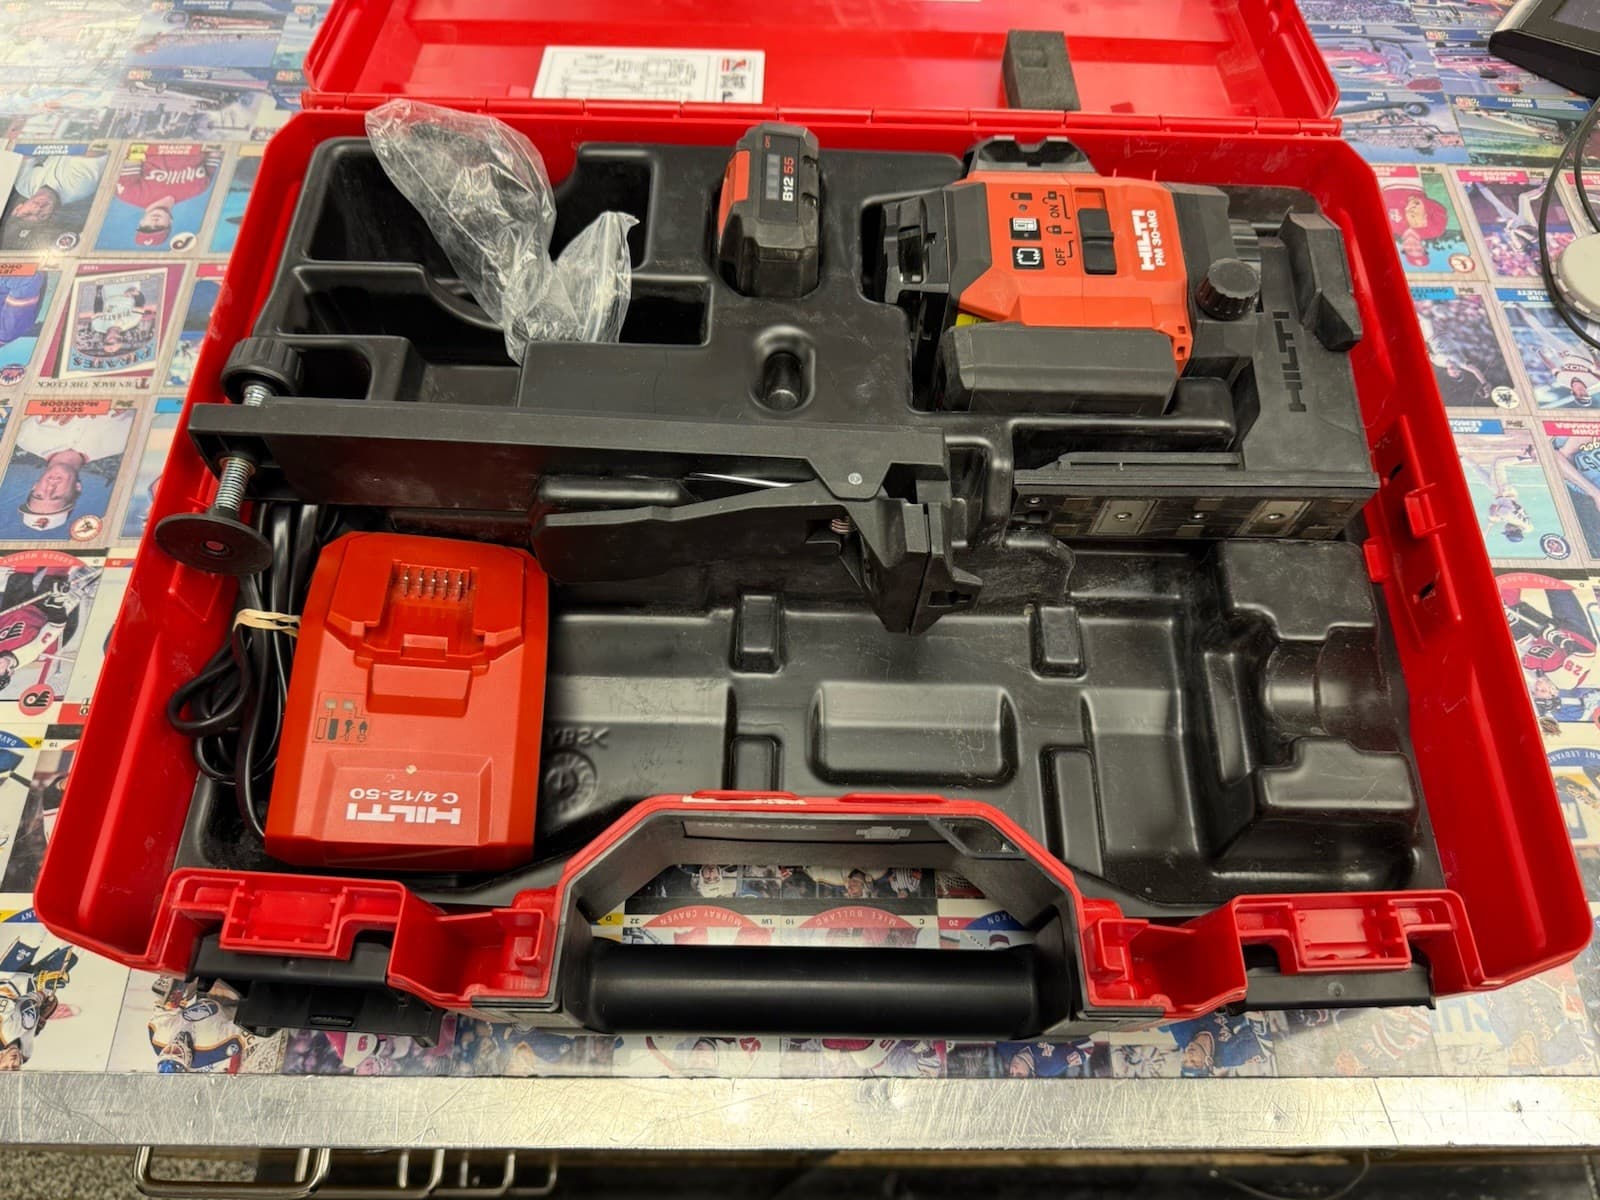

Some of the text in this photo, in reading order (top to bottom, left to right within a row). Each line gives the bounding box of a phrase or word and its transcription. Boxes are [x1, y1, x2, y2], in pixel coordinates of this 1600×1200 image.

[782, 156, 795, 201] B12 55
[1049, 205, 1060, 218] ON
[1131, 209, 1155, 271] HILTI
[1147, 210, 1166, 266] PM 30-MG
[1055, 248, 1067, 266] OFF
[1272, 307, 1307, 412] HILTI
[349, 788, 459, 804] C 4/12-50
[346, 803, 461, 825] HILTI
[631, 918, 641, 926] 32
[659, 910, 698, 925] CRAVEN
[703, 910, 744, 926] MURRAY
[814, 910, 884, 926] BULLARD
[891, 910, 917, 926] MIKE
[948, 919, 961, 927] 20
